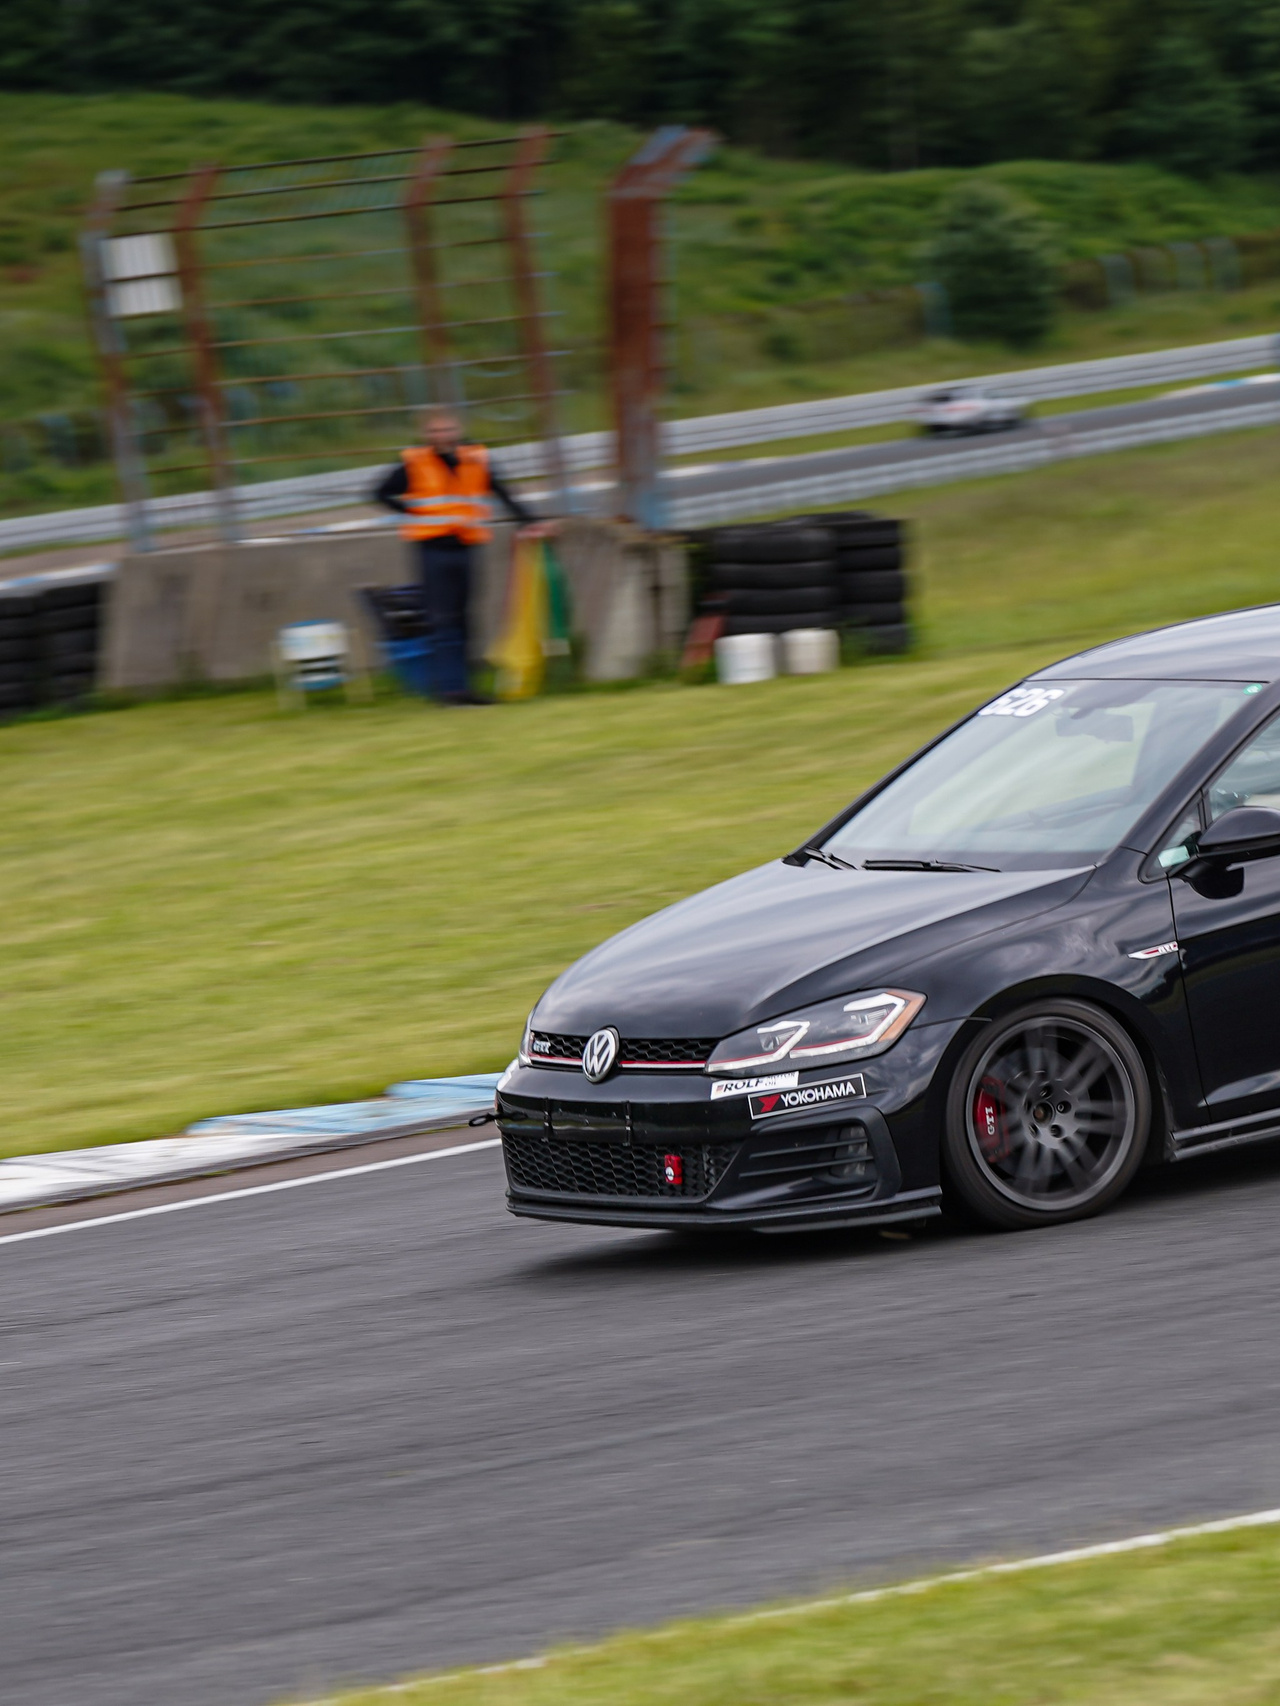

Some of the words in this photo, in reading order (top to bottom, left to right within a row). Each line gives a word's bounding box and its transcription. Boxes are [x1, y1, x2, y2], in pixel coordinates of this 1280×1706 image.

[979, 688, 1064, 717] 626
[723, 1078, 763, 1092] ROLF
[781, 1081, 856, 1107] YOKOHAMA
[984, 1106, 996, 1135] GTI
